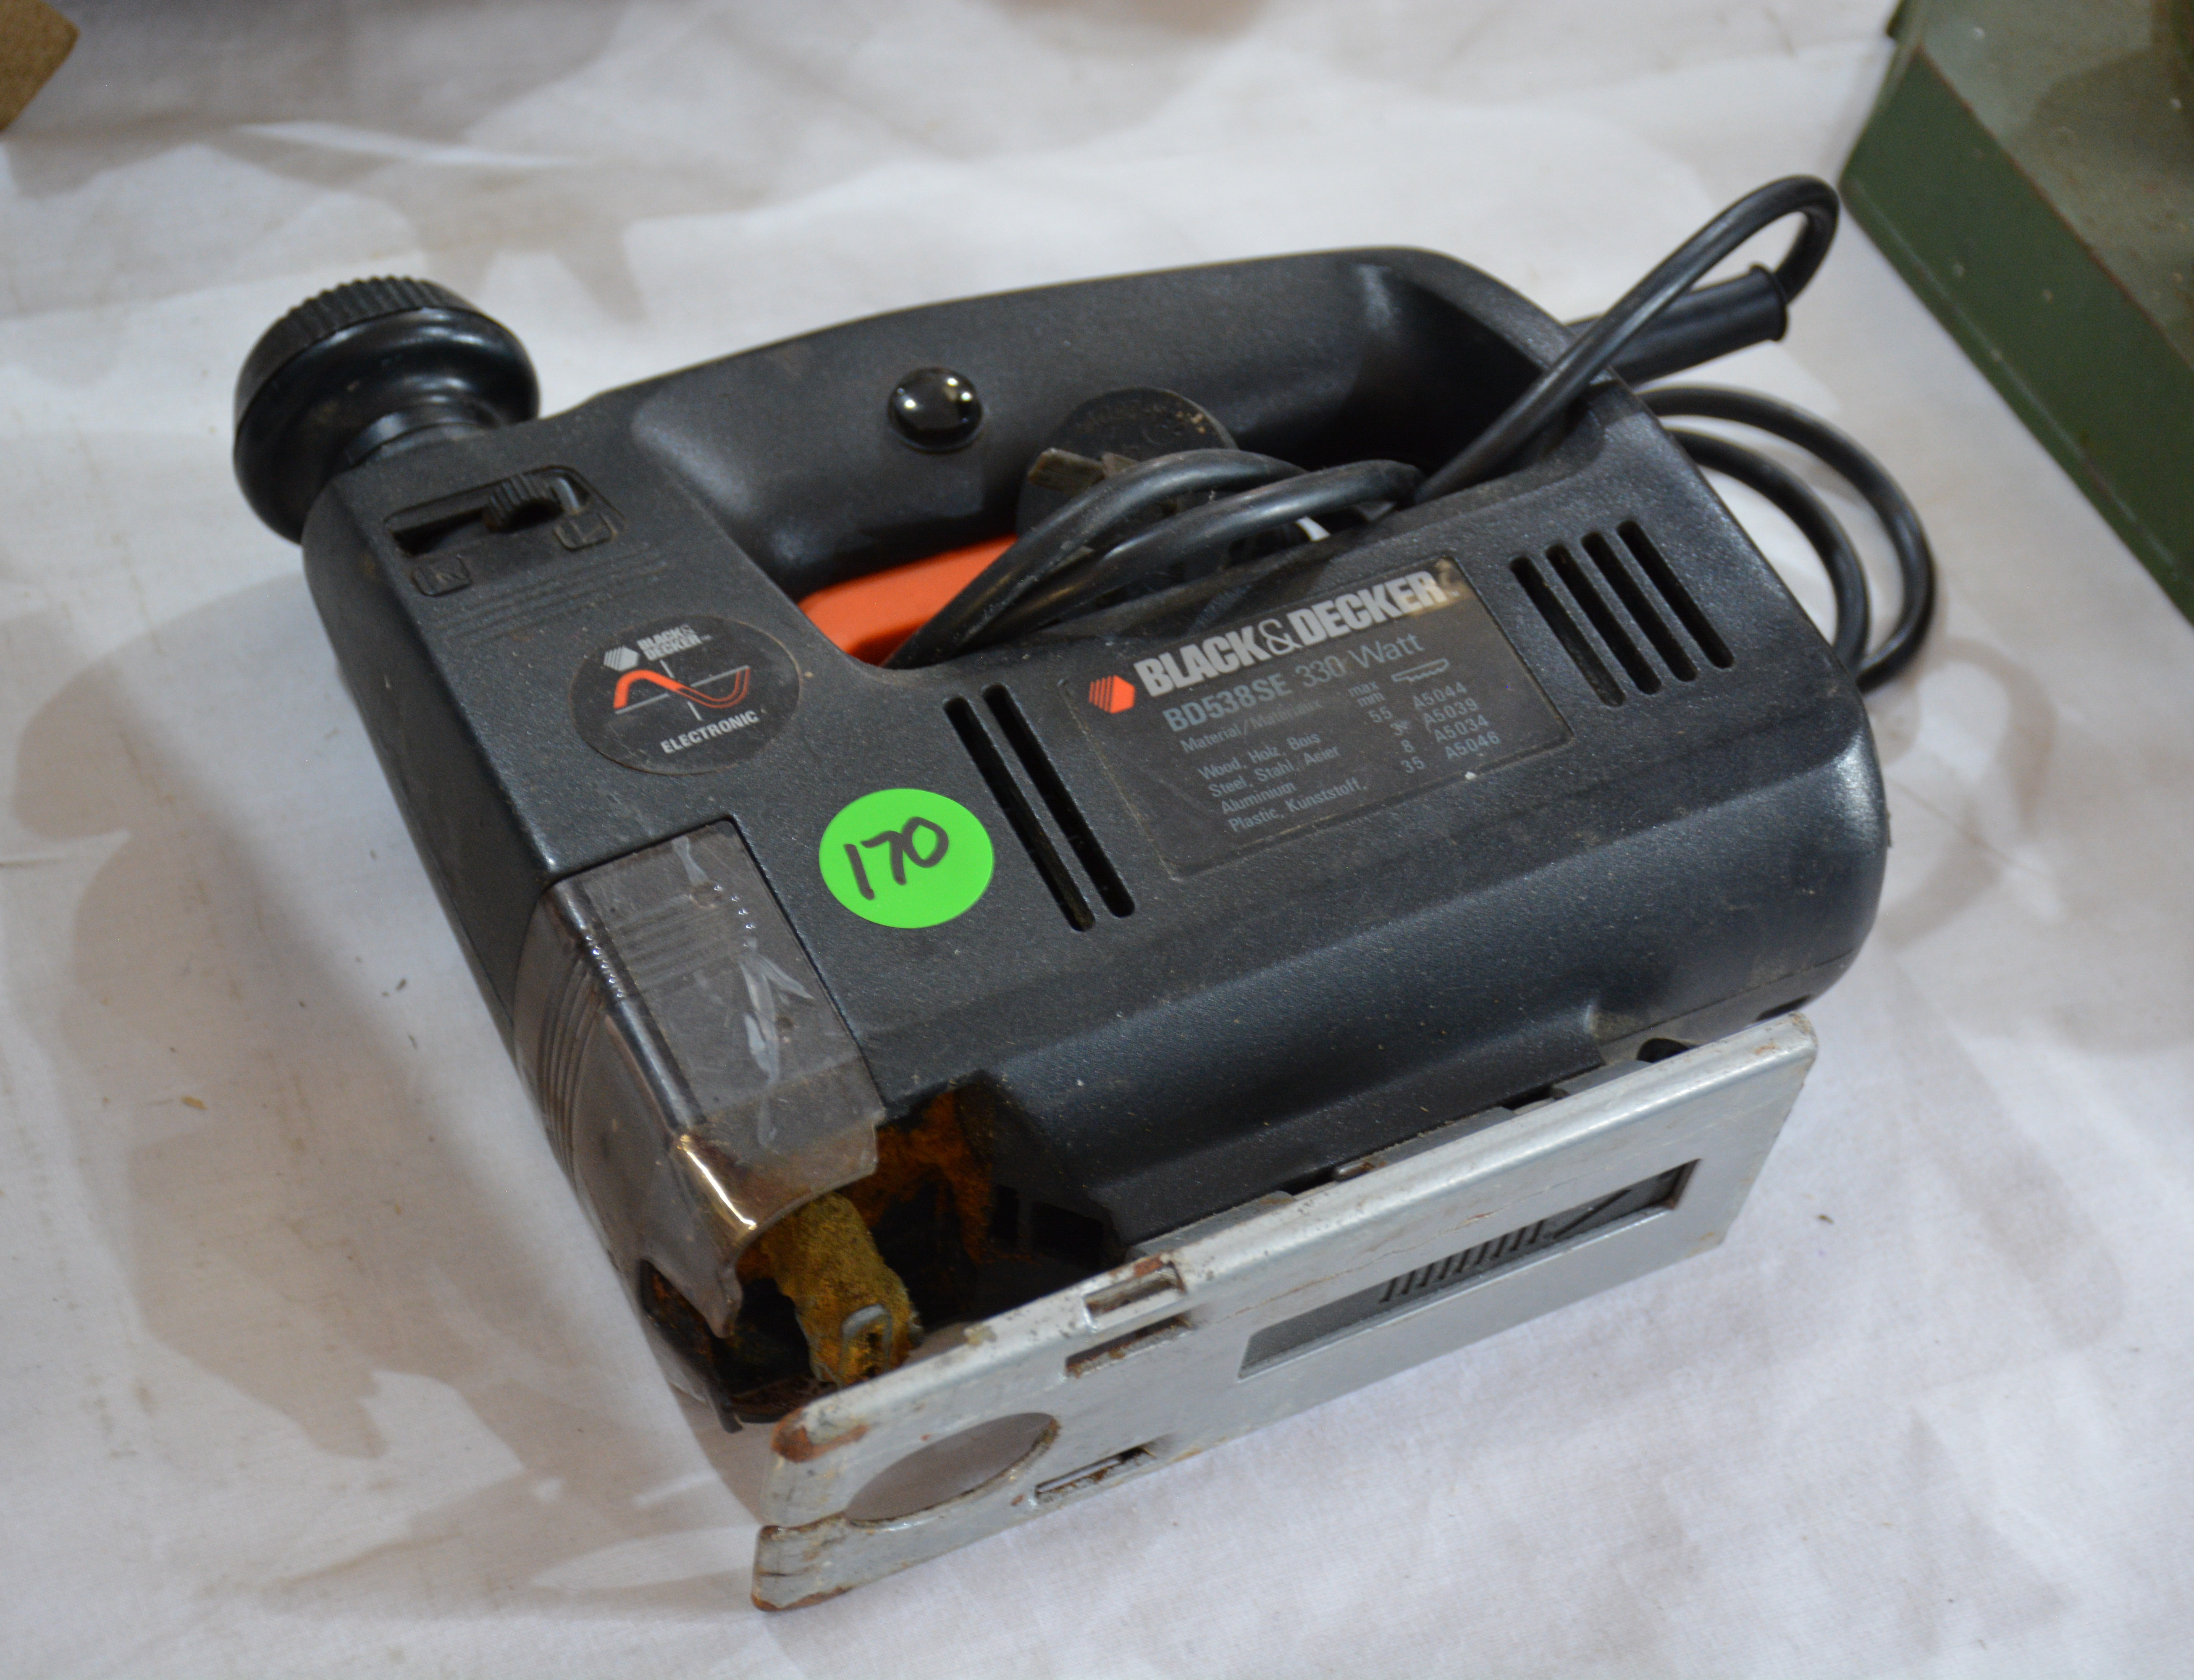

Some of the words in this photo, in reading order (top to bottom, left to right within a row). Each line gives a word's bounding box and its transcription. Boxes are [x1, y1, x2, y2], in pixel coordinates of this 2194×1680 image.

[637, 624, 696, 650] BLACK&
[643, 634, 703, 661] DECKER
[1134, 571, 1448, 697] BLACK&DECKER
[1163, 673, 1292, 732] BD538SE
[1295, 655, 1345, 687] 330
[1347, 633, 1425, 669] Watt
[1348, 681, 1379, 697] max
[1357, 692, 1385, 707] mm
[660, 709, 761, 754] ELECTRONIC
[1286, 732, 1321, 751] Bois
[1368, 706, 1393, 723] 55
[1412, 681, 1468, 710] A5044
[1303, 745, 1341, 766] Acier
[1423, 697, 1479, 726] A5039
[1220, 781, 1298, 814] Aluminium
[1401, 739, 1415, 753] 8
[1434, 714, 1489, 743] A5034
[1401, 756, 1426, 774] 35
[1445, 730, 1501, 759] A5046
[843, 816, 949, 901] 170
